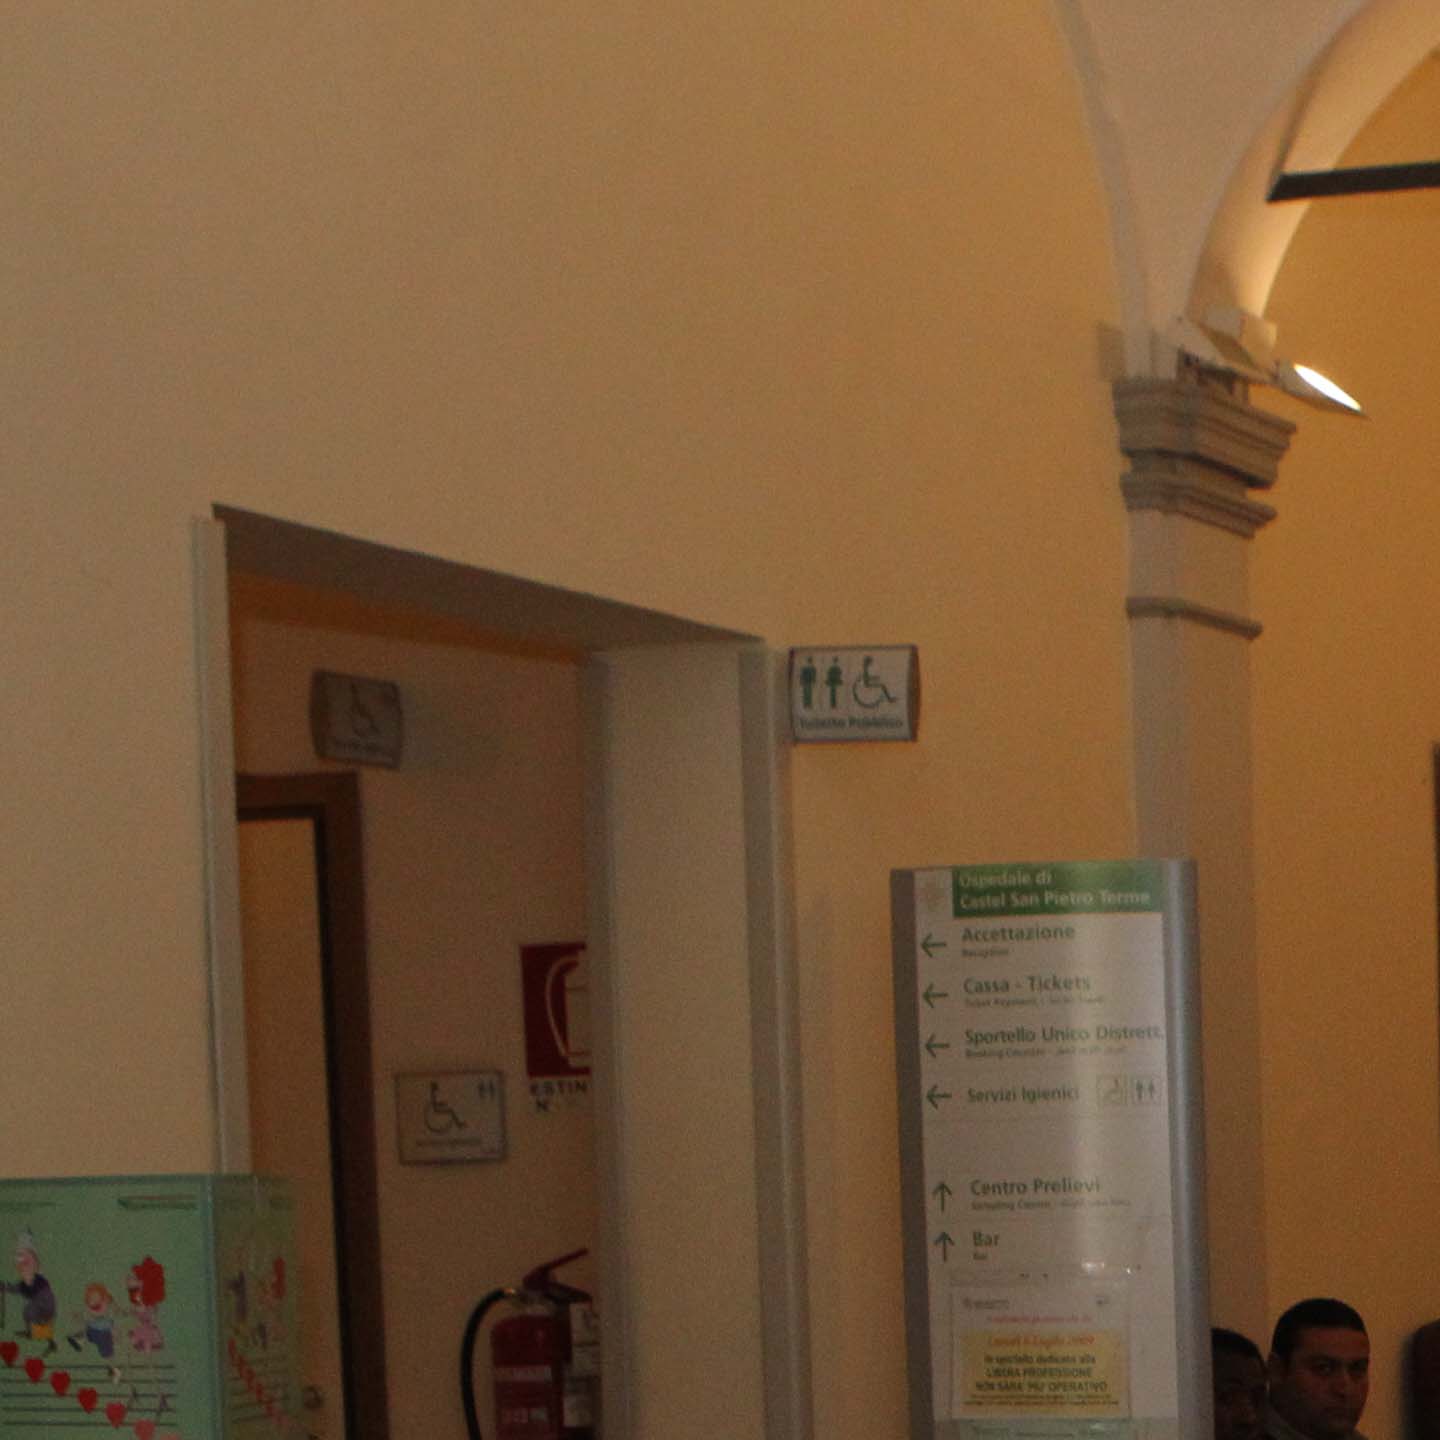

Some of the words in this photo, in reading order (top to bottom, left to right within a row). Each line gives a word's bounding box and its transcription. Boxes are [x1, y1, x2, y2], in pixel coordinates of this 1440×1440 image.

[958, 871, 1031, 887] Ospedale
[1036, 870, 1051, 884] di
[960, 894, 1006, 909] Castel
[1011, 891, 1039, 906] San
[1044, 891, 1093, 905] Pietro
[1100, 890, 1150, 903] Terme
[962, 924, 1075, 942] Accettazione
[963, 978, 1009, 994] Cassa
[965, 1029, 1036, 1046] Sportello
[1042, 1027, 1090, 1042] Unico
[970, 1180, 1027, 1196] Centro
[973, 1231, 999, 1246] Bar
